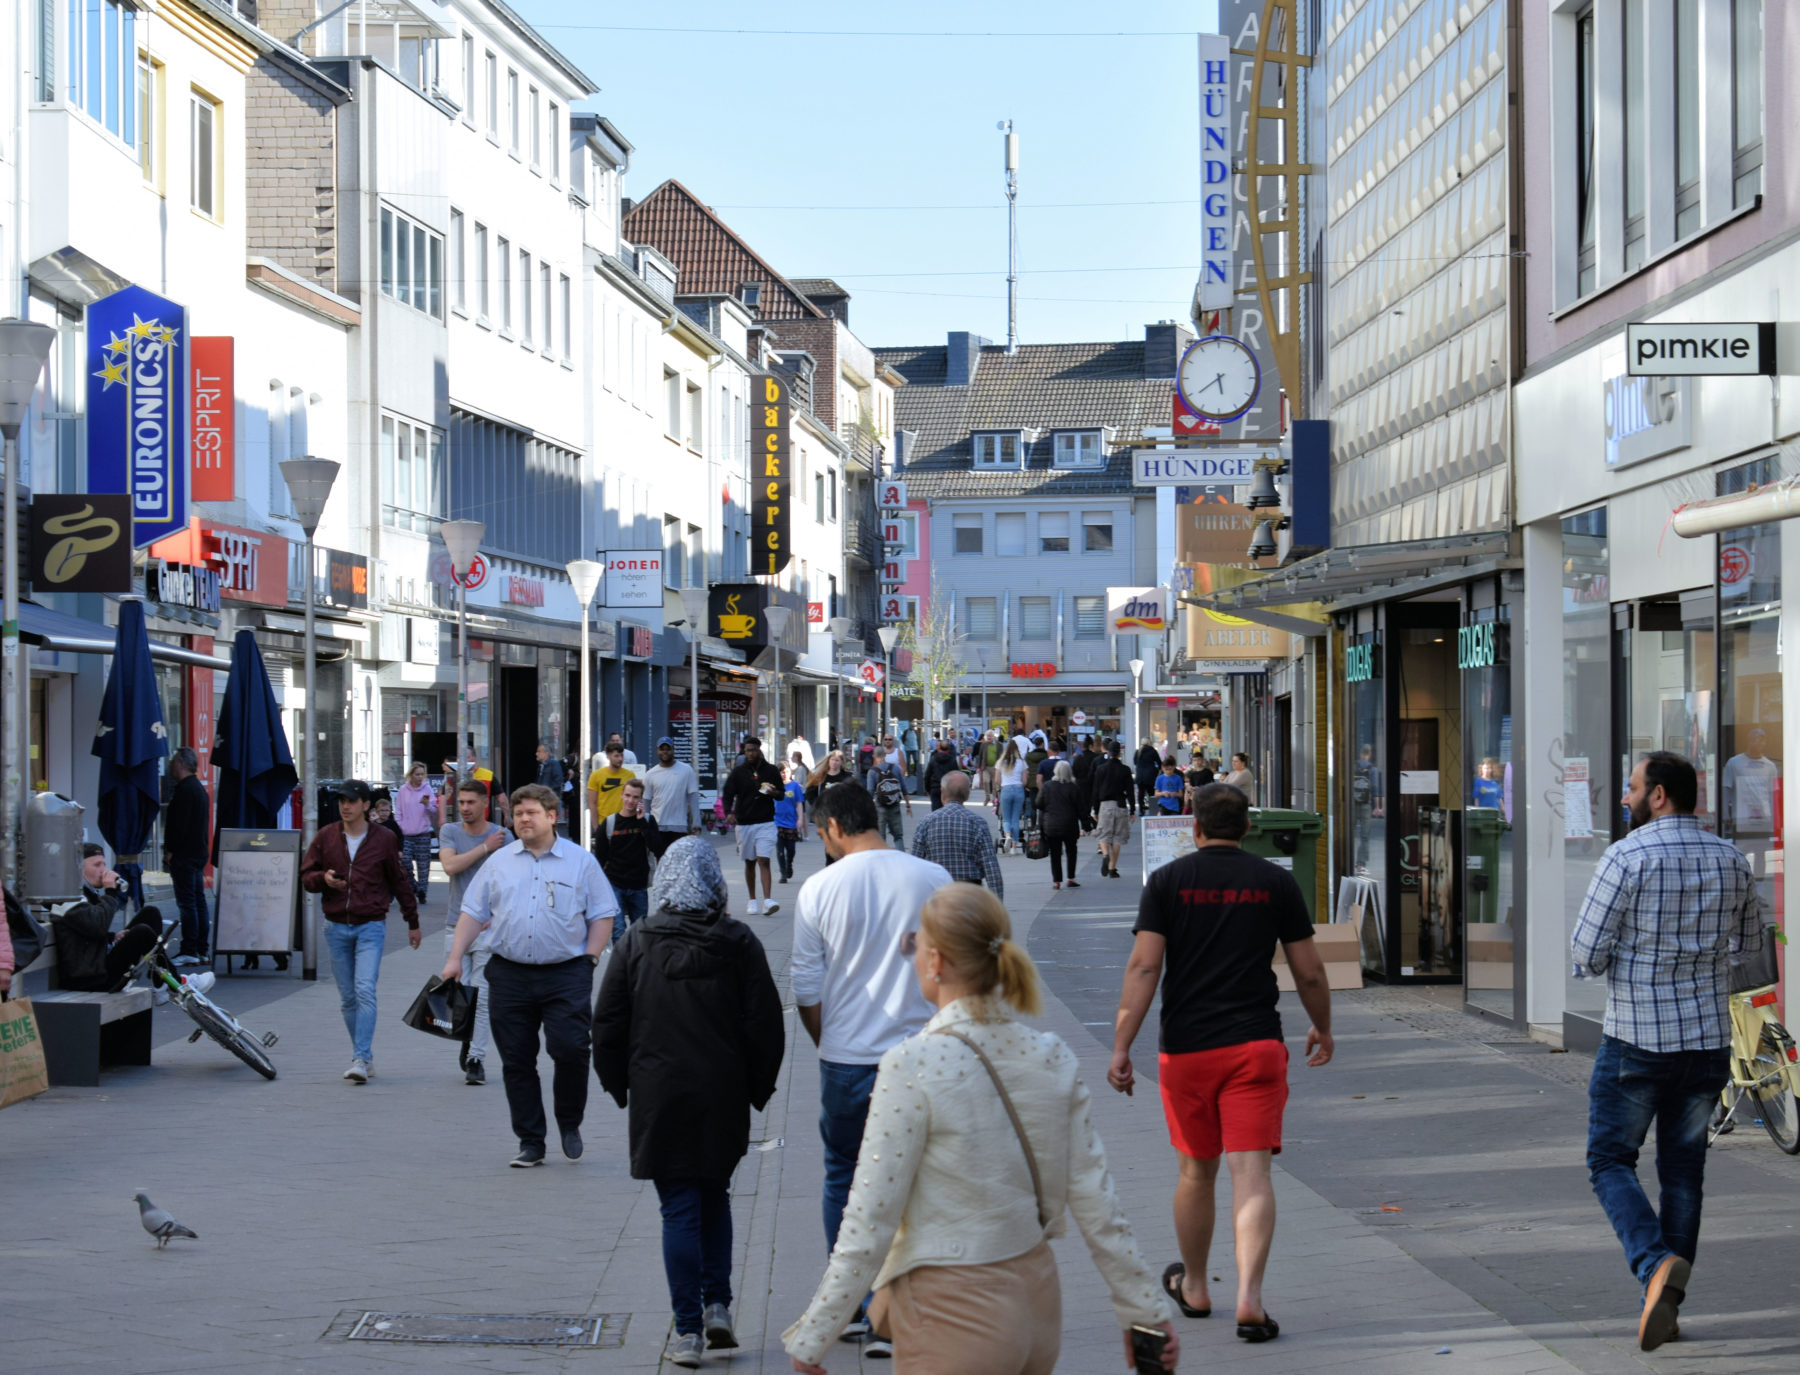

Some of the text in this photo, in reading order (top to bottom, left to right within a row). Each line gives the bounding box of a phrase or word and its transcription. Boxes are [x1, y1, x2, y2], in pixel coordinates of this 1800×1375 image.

[1203, 60, 1227, 285] HÜNDGEN
[1637, 337, 1750, 366] pimkie
[134, 342, 163, 510] EURONICS
[195, 368, 221, 469] ESPRIT
[764, 378, 780, 574] bäckerei
[1143, 456, 1256, 478] HÜNDGE
[608, 560, 660, 571] JONEN
[620, 574, 647, 582] hören
[620, 591, 648, 599] sehen
[1124, 596, 1158, 617] dm
[1204, 629, 1272, 647] ABELER
[1458, 622, 1495, 669] DOUGLAS
[1011, 663, 1057, 679] NKD
[1346, 643, 1373, 682] DOUGLAS
[0, 1031, 37, 1054] eters
